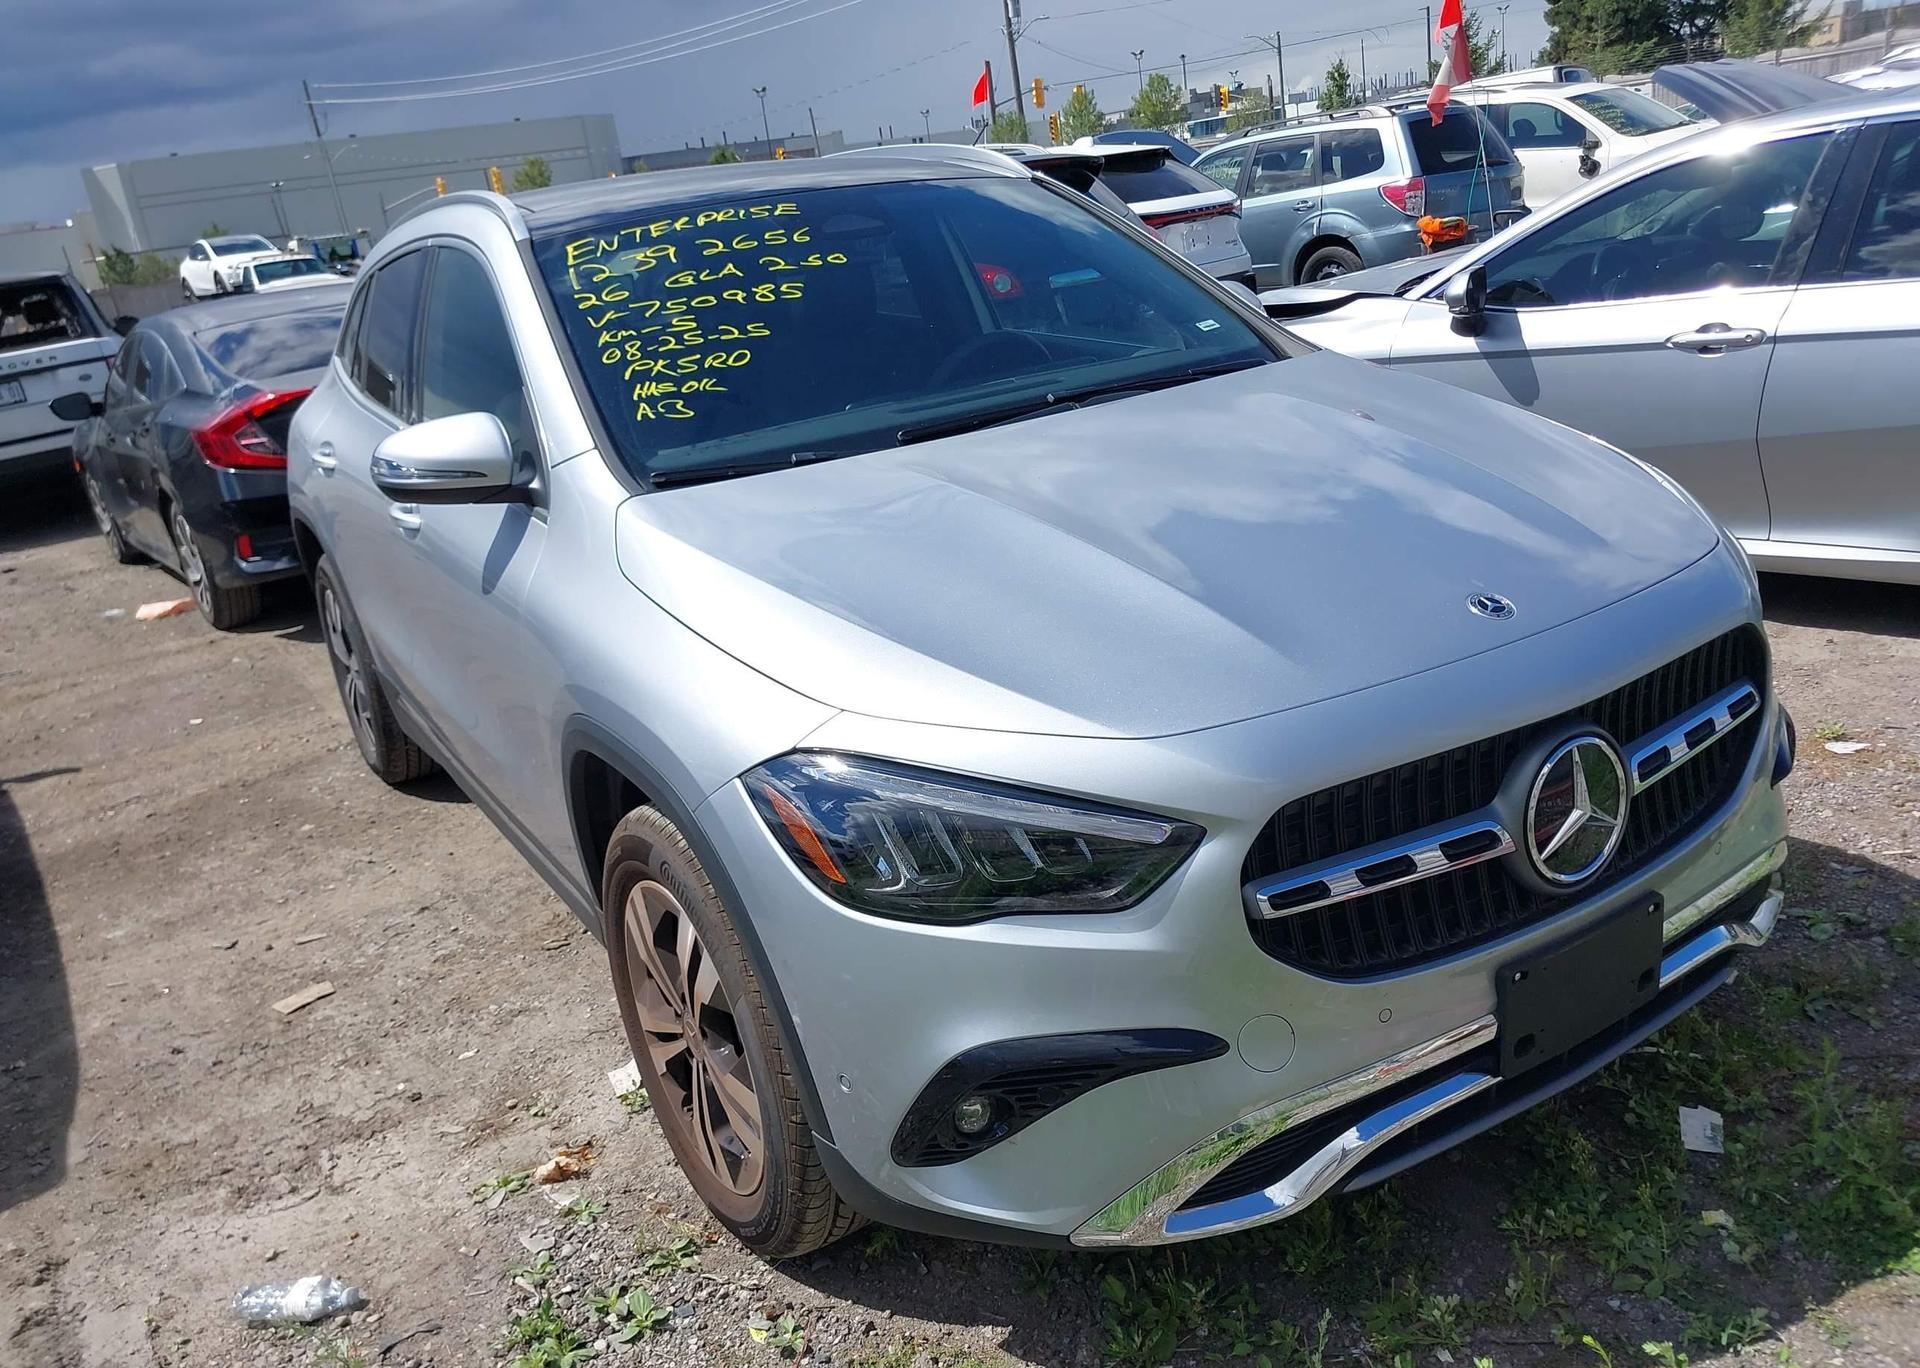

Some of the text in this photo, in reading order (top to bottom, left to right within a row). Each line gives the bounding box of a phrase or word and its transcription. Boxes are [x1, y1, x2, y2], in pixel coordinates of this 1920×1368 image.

[566, 203, 801, 266] ENTERPRISE
[695, 227, 811, 256] 2656
[574, 253, 848, 310] 26 GLA 250
[601, 322, 771, 364] 08-25-25
